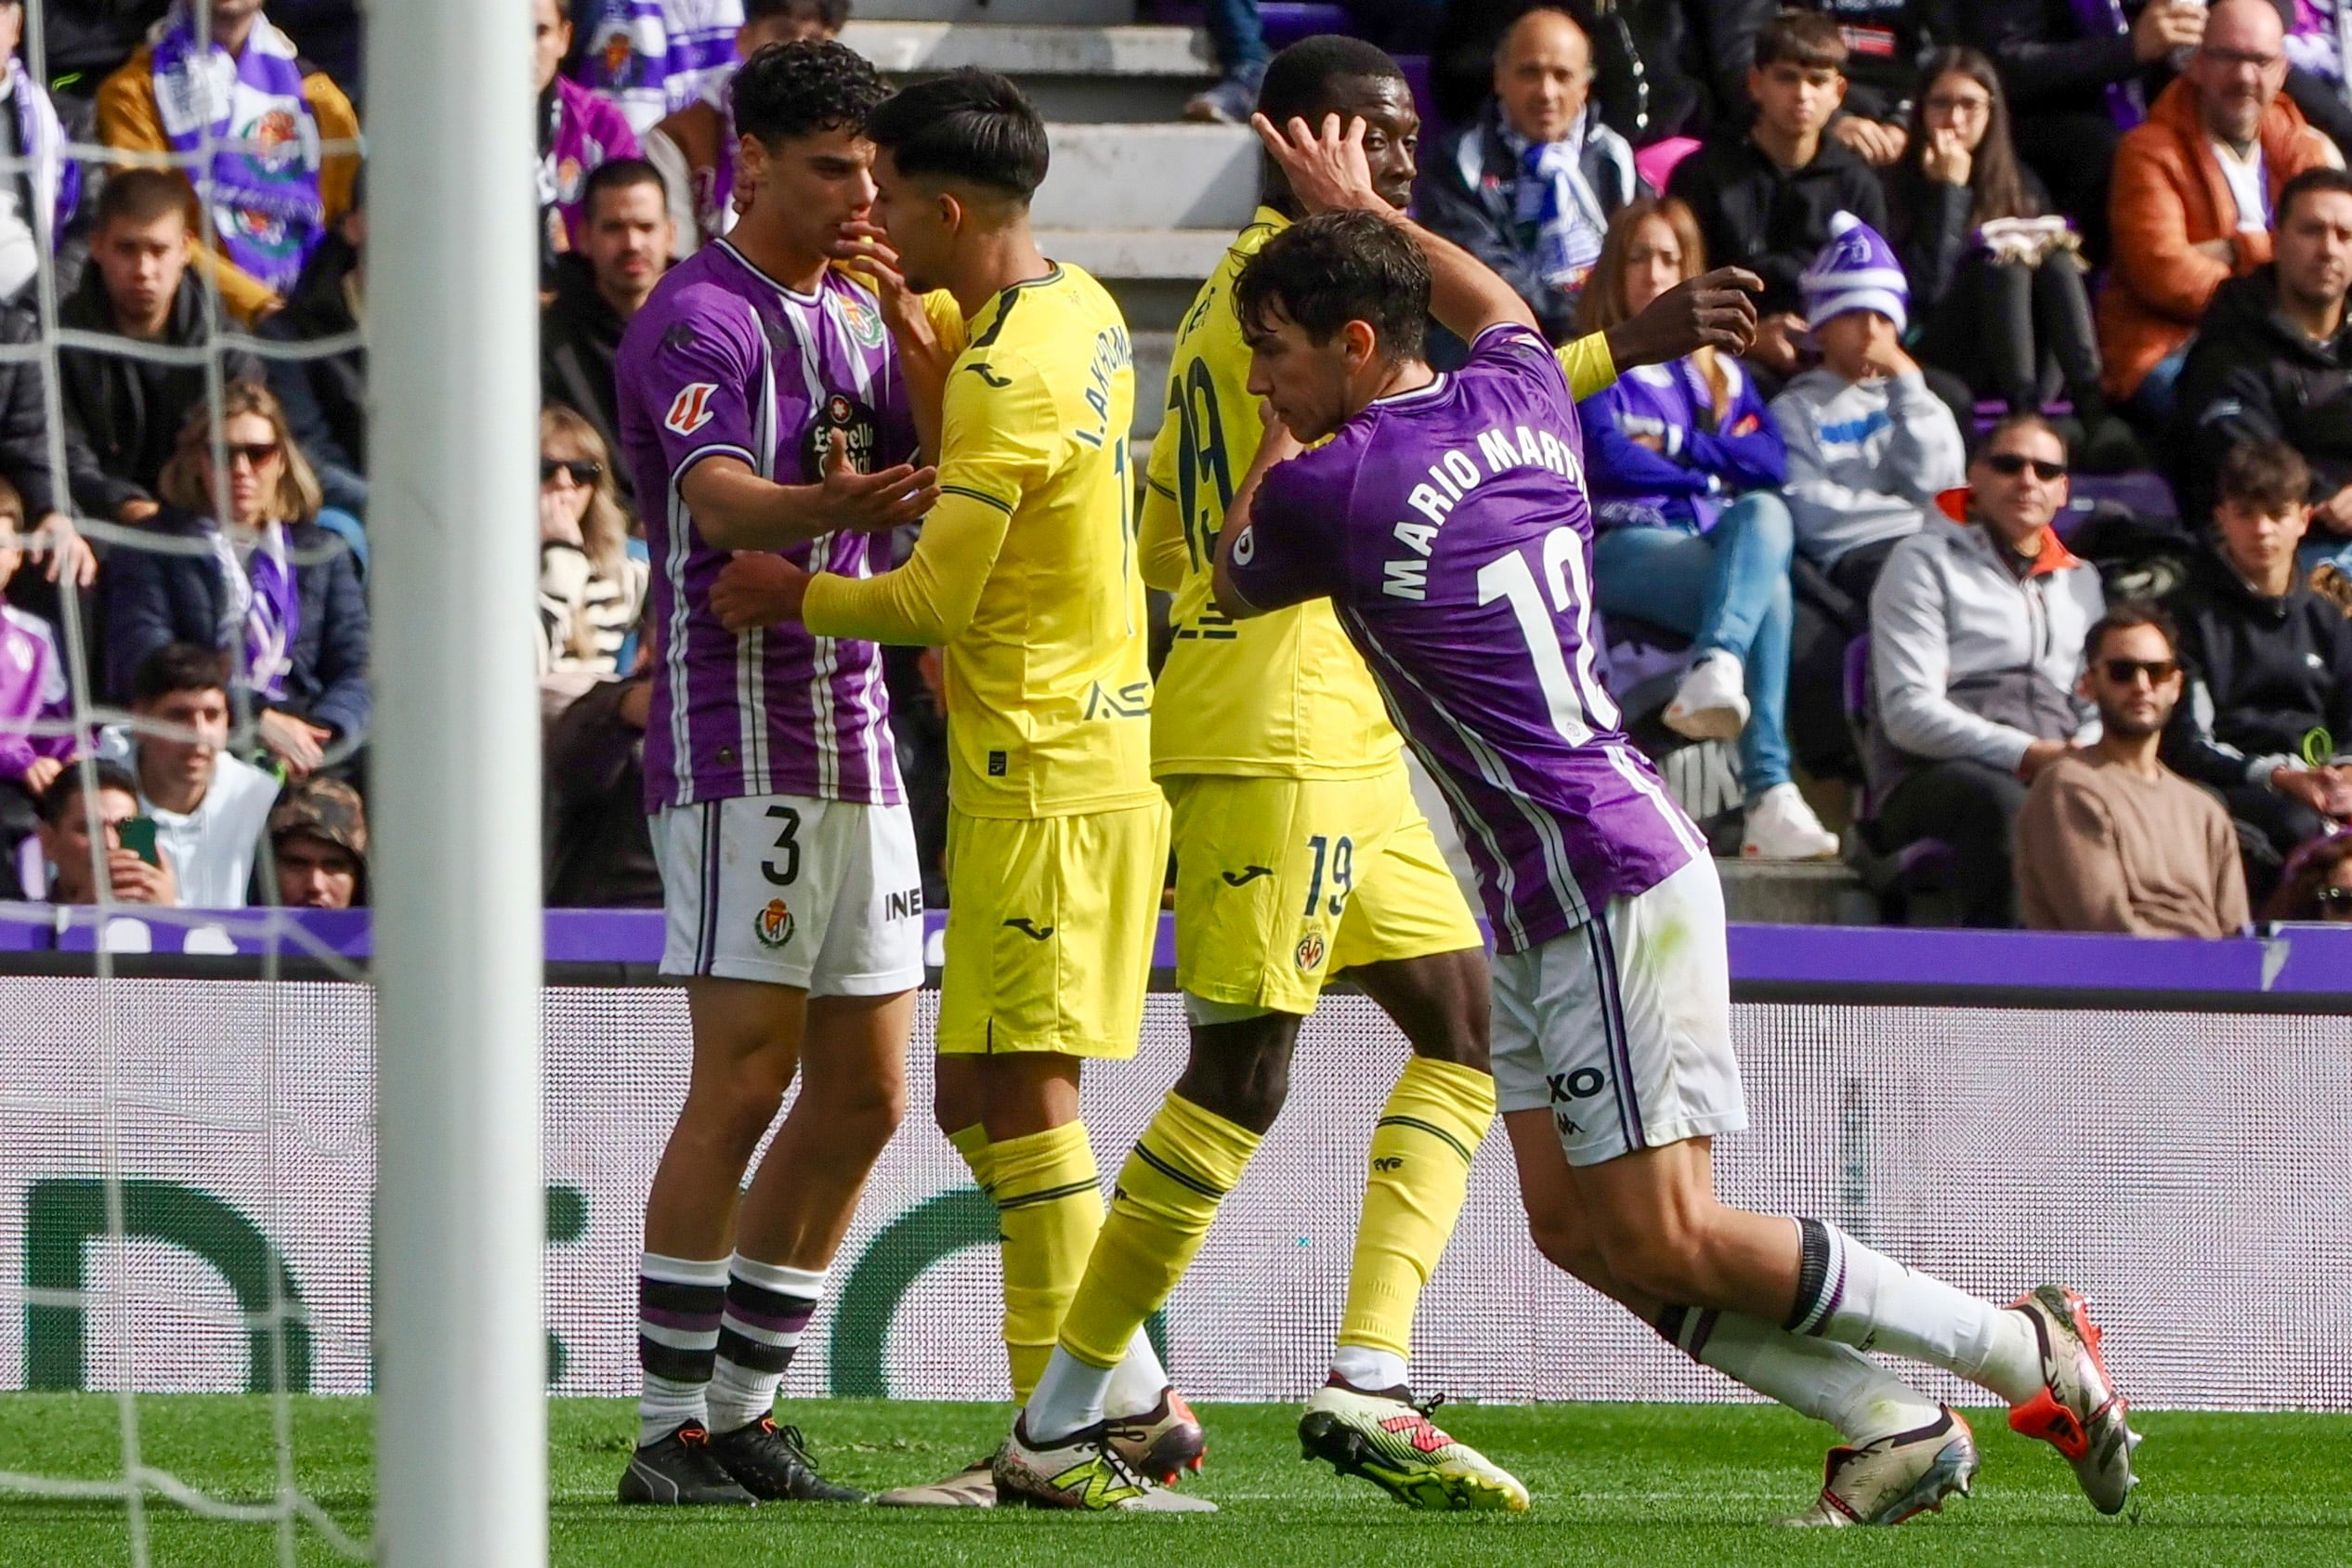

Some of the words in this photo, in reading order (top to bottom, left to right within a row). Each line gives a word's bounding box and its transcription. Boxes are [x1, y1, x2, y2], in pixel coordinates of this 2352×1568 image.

[1168, 356, 1234, 575] 19
[1382, 450, 1482, 601] MARIO
[1477, 526, 1619, 748] 12
[761, 804, 802, 886] 3
[1303, 835, 1353, 916] 19
[884, 888, 922, 921] INE
[1546, 1067, 1605, 1104] XO
